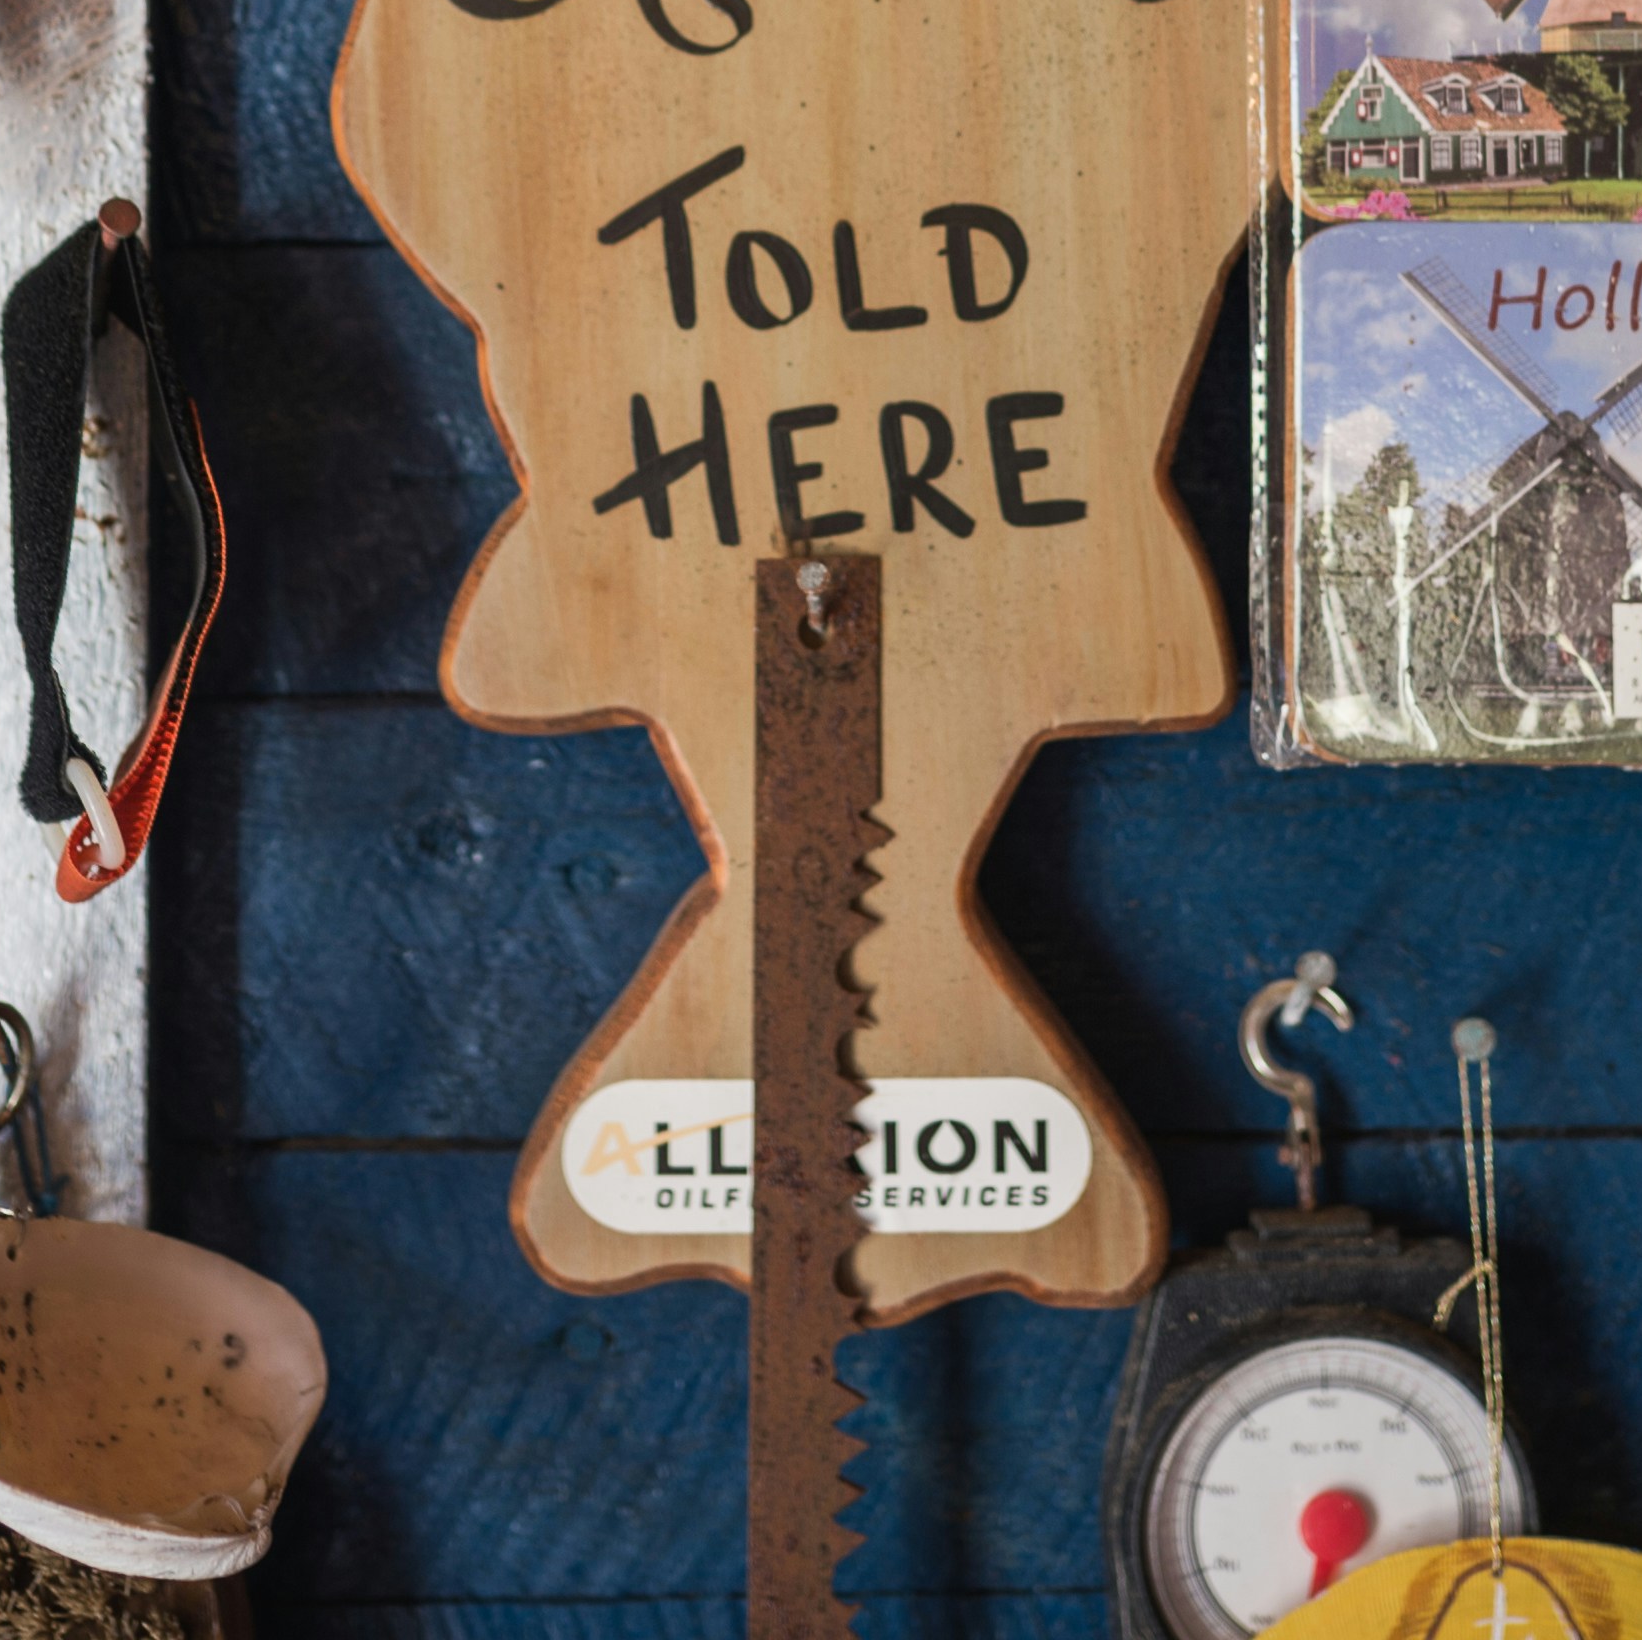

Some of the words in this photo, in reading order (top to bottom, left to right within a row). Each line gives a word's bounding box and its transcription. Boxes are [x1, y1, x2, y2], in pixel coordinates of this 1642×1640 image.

[597, 145, 1029, 331] TOLD
[592, 380, 1087, 546] HERE
[580, 1118, 1049, 1177] ALLION
[853, 1185, 1050, 1208] SERVICES
